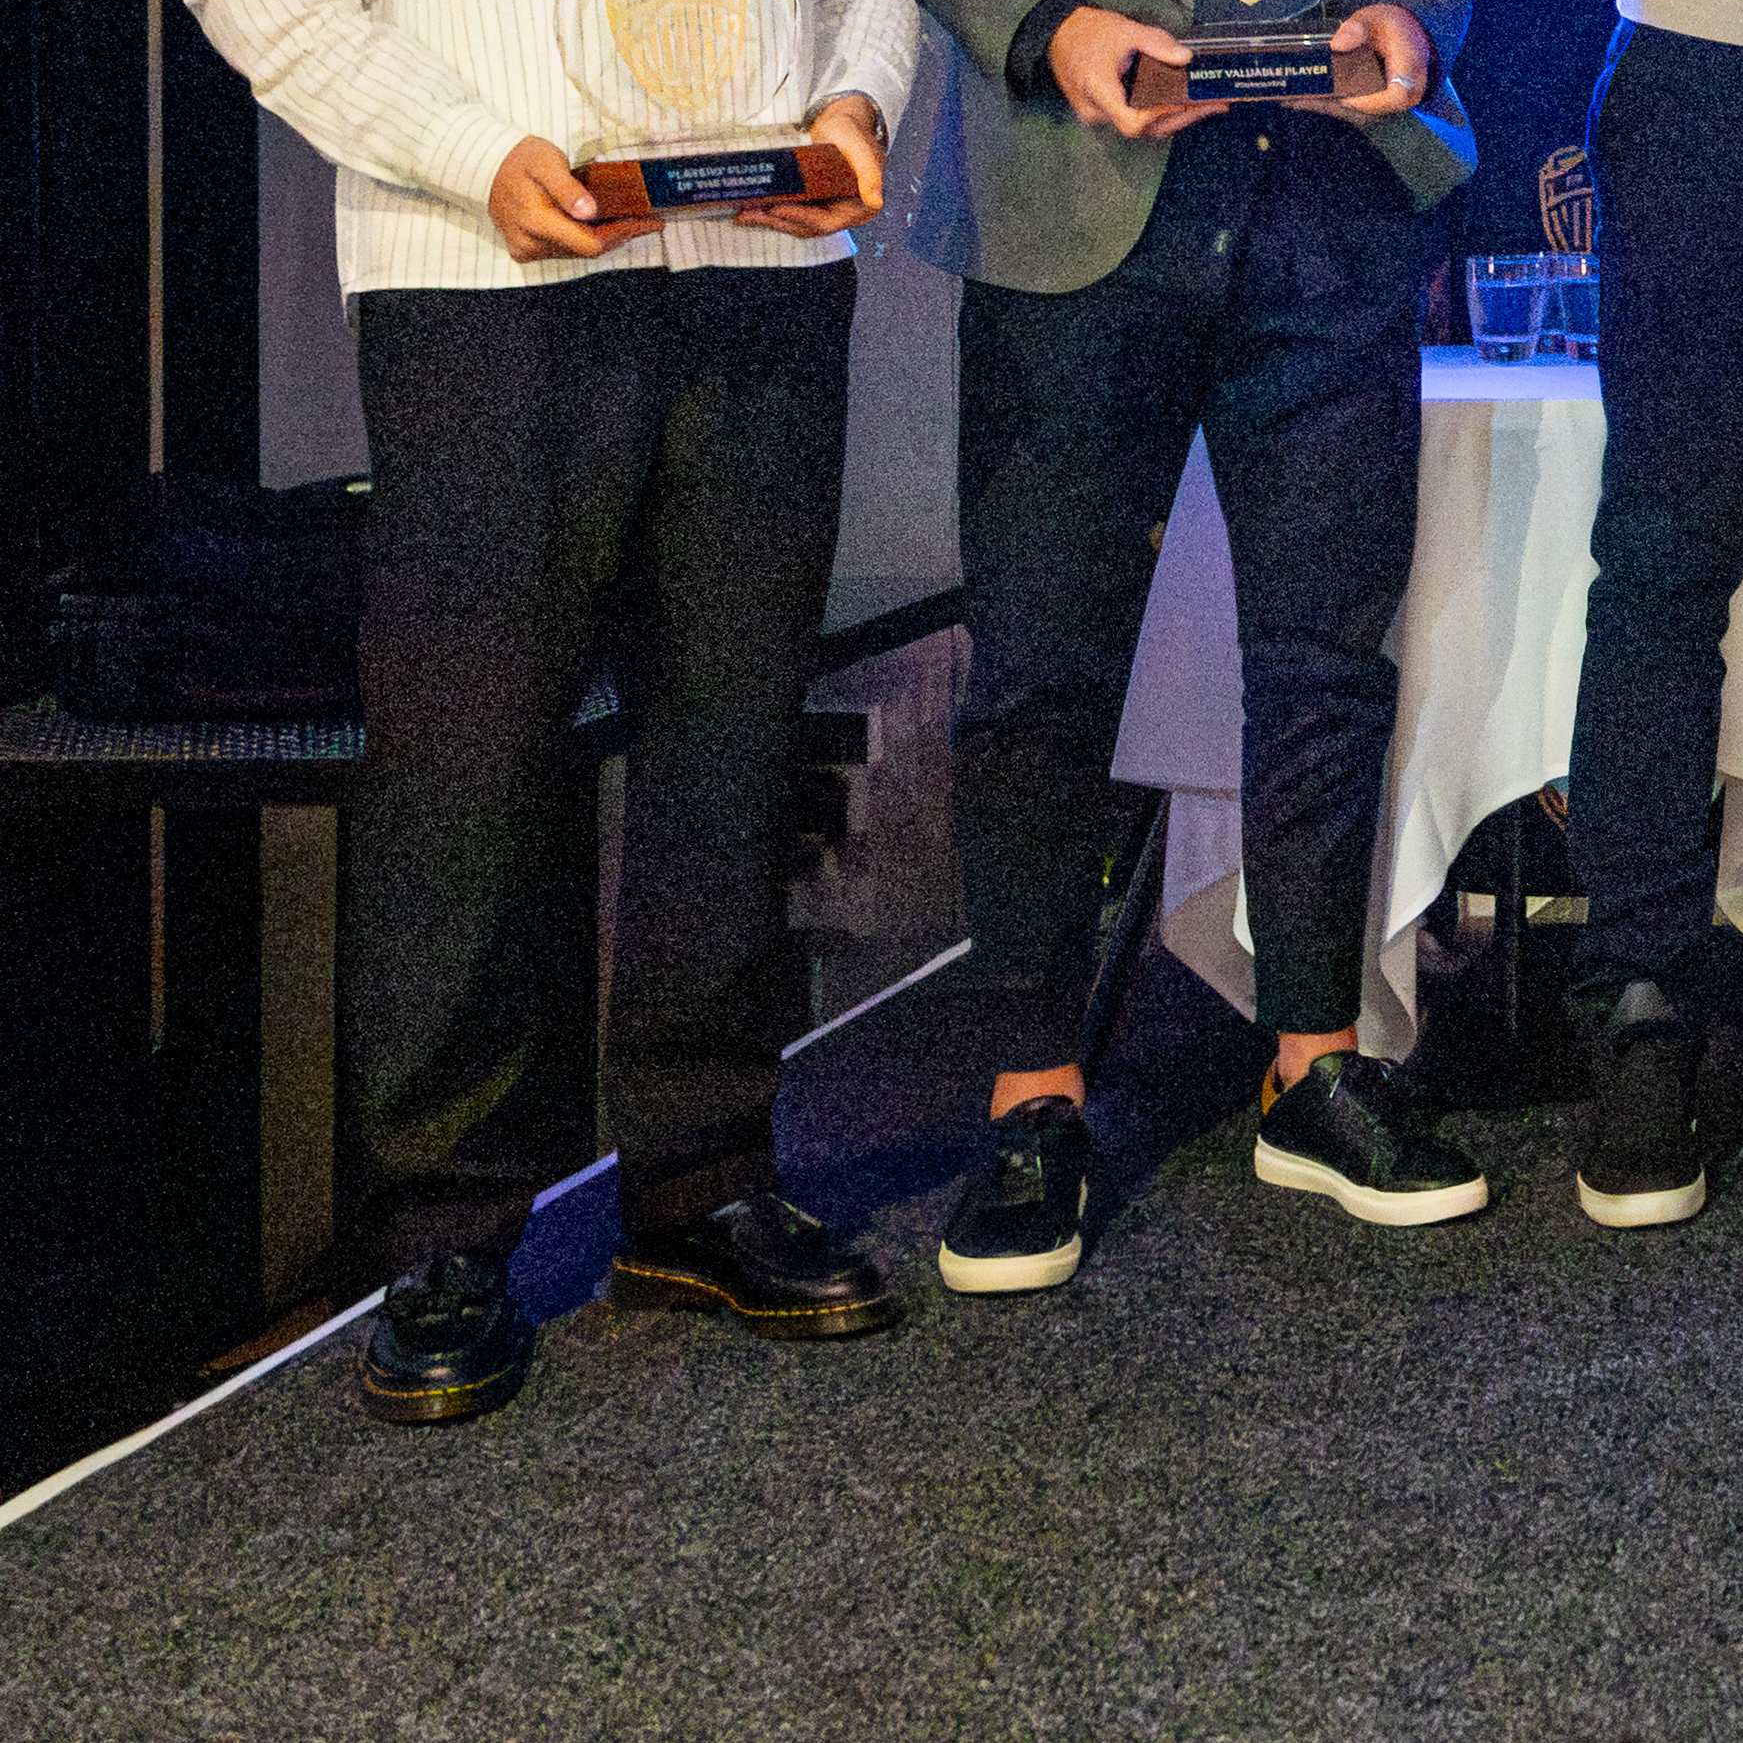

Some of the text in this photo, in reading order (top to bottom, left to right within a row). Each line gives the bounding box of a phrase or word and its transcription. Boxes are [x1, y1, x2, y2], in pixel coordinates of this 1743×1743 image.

[1190, 65, 1328, 80] MOST VALUABLE PLAYER
